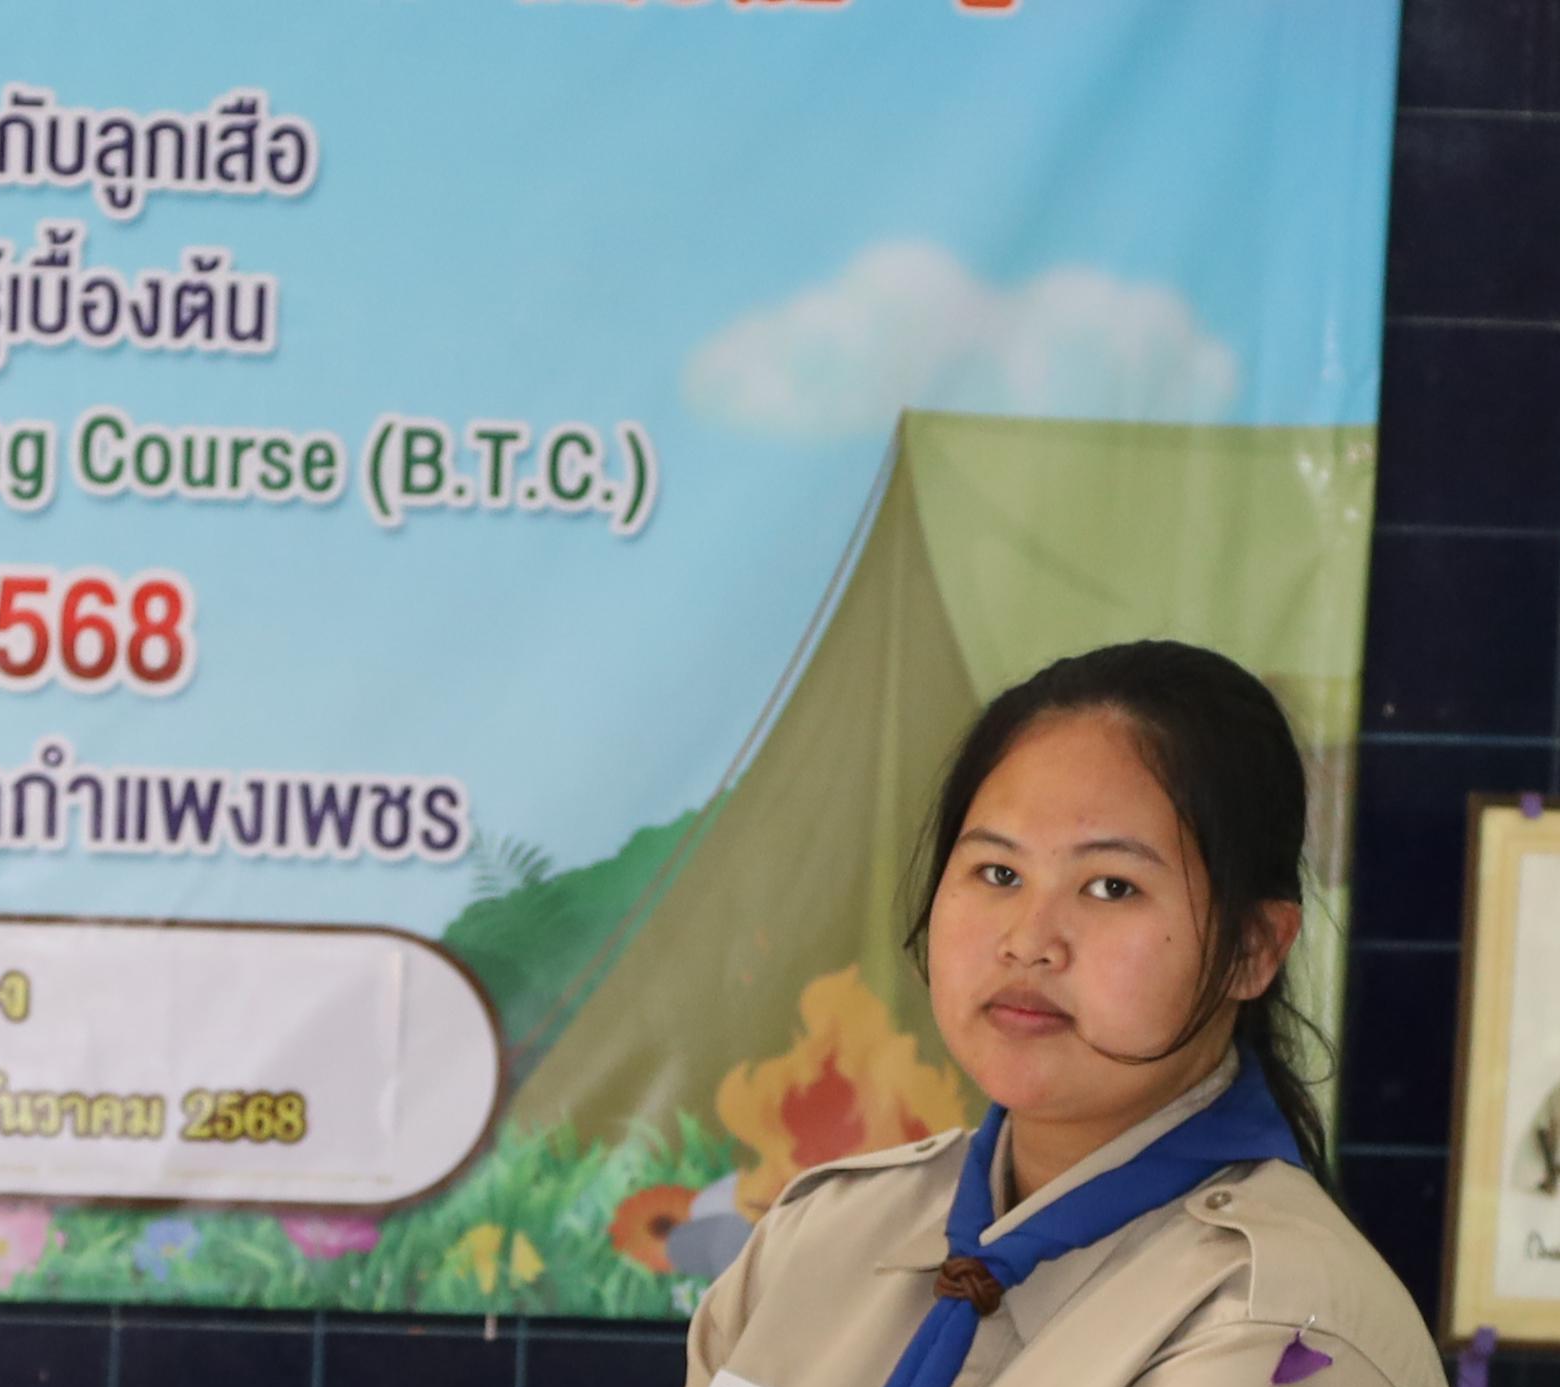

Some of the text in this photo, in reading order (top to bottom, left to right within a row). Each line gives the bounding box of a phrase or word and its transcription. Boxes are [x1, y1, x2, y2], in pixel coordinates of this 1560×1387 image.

[80, 414, 337, 492] Course
[370, 420, 648, 526] (B.T.C.)
[180, 1088, 308, 1146] 2568
